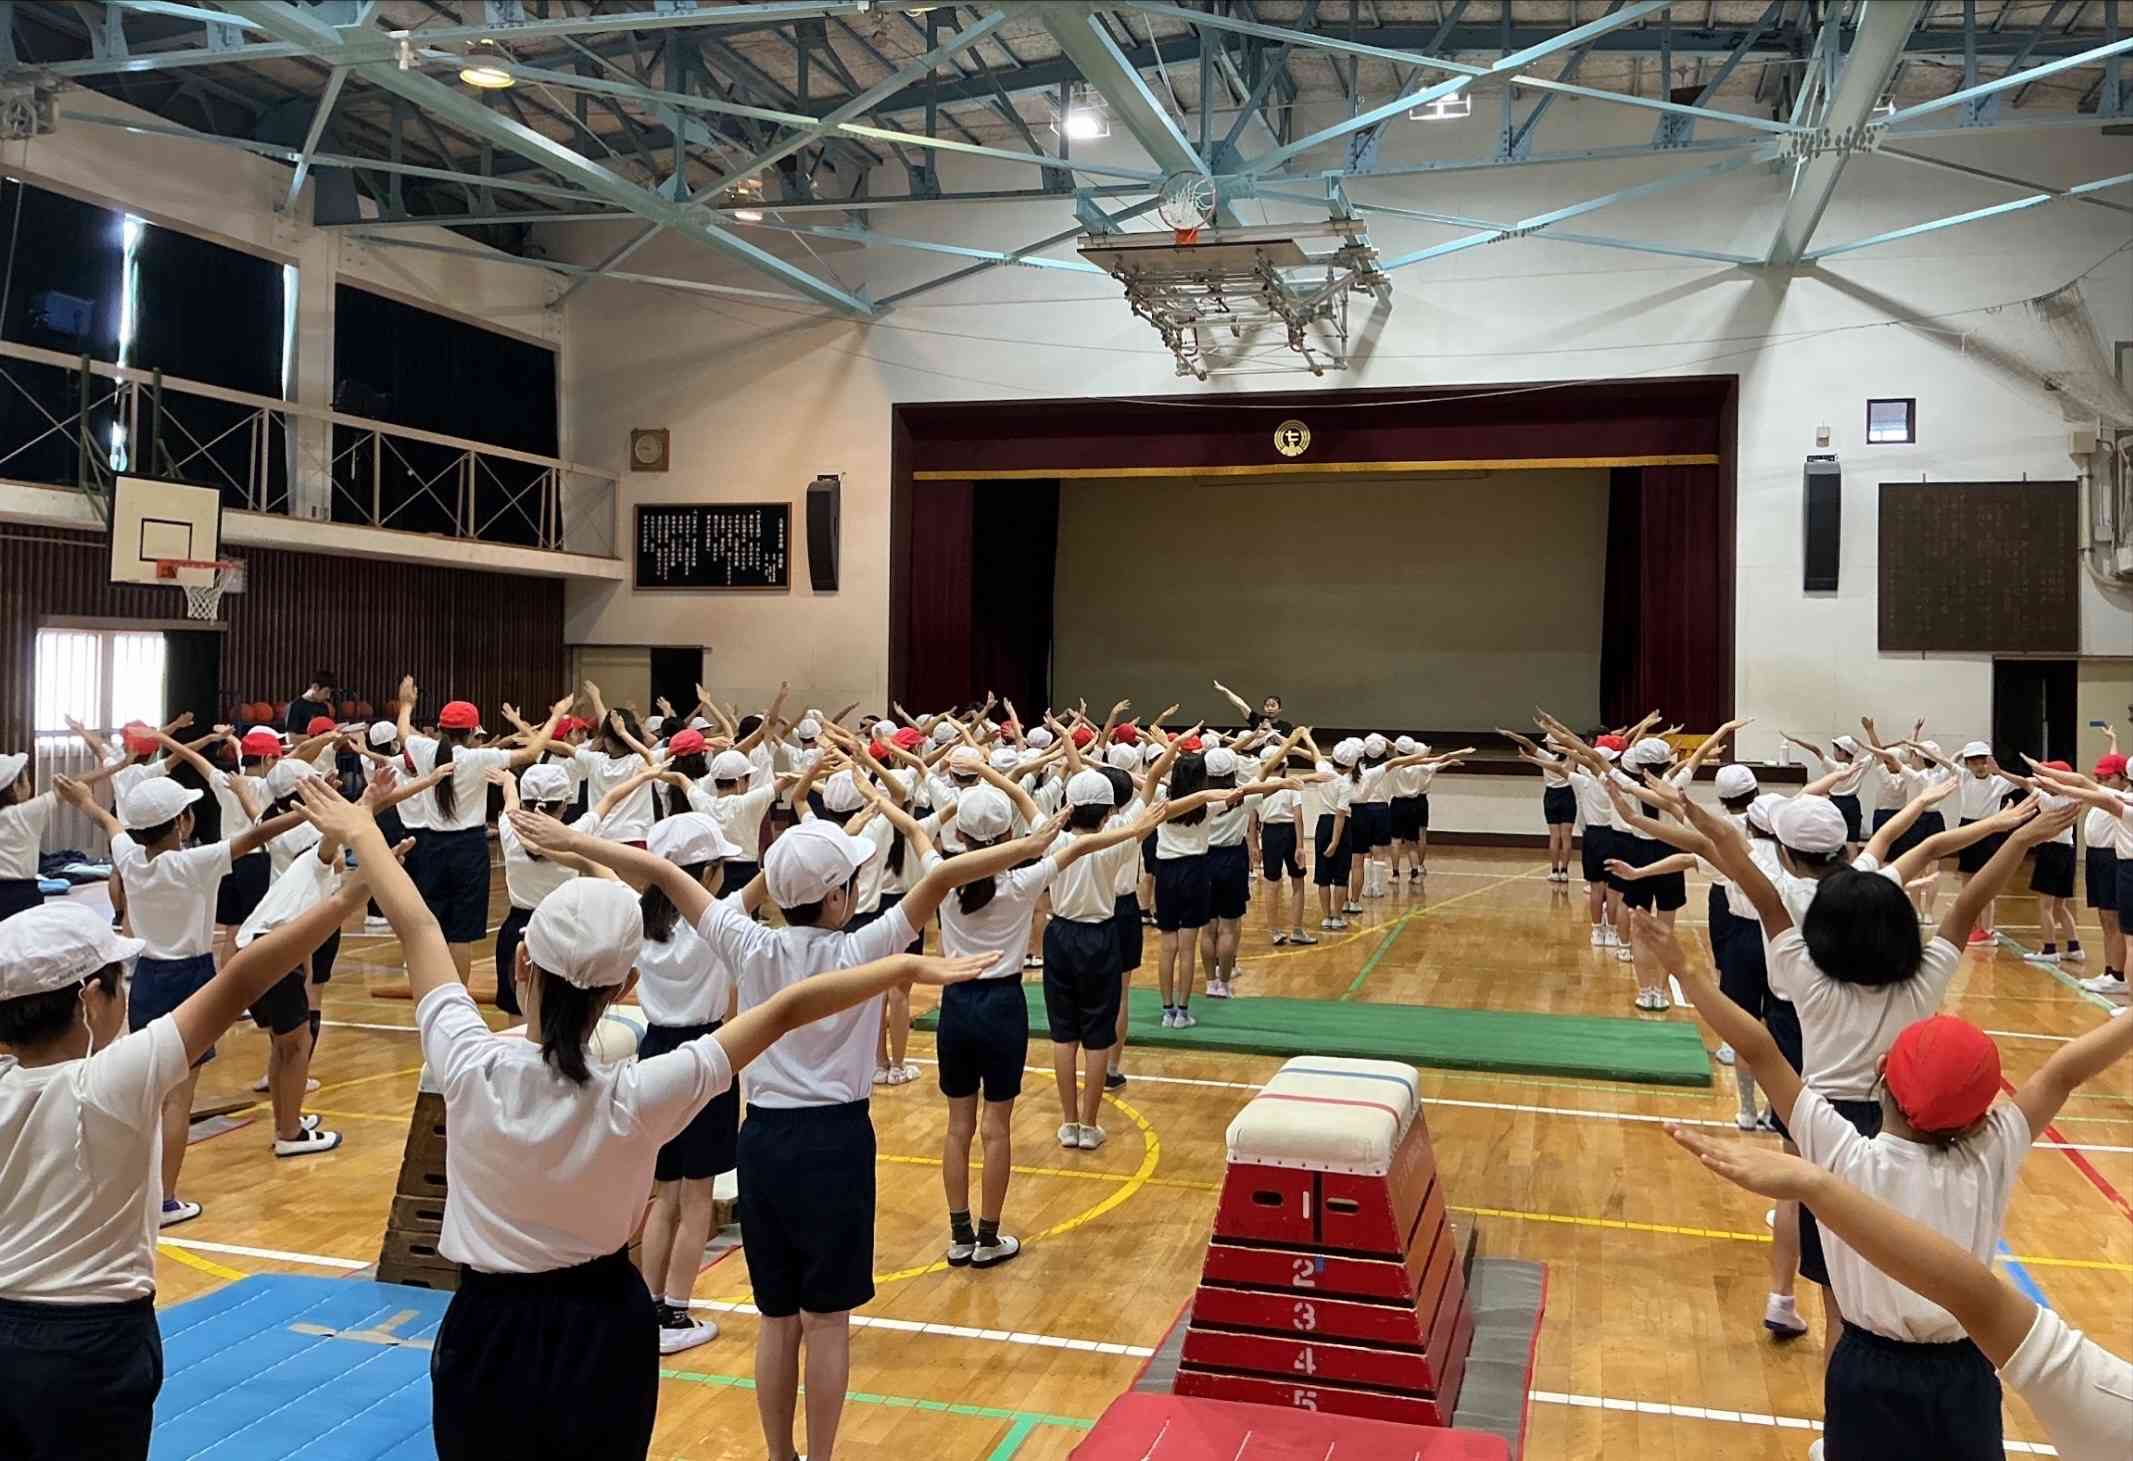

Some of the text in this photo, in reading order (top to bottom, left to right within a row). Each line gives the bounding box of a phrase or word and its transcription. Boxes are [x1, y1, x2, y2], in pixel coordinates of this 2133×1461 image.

[1302, 1191, 1310, 1219] 1
[1292, 1259, 1316, 1287] 2
[1293, 1302, 1316, 1330] 3
[1294, 1347, 1317, 1374] 4
[1294, 1390, 1317, 1411] 5
